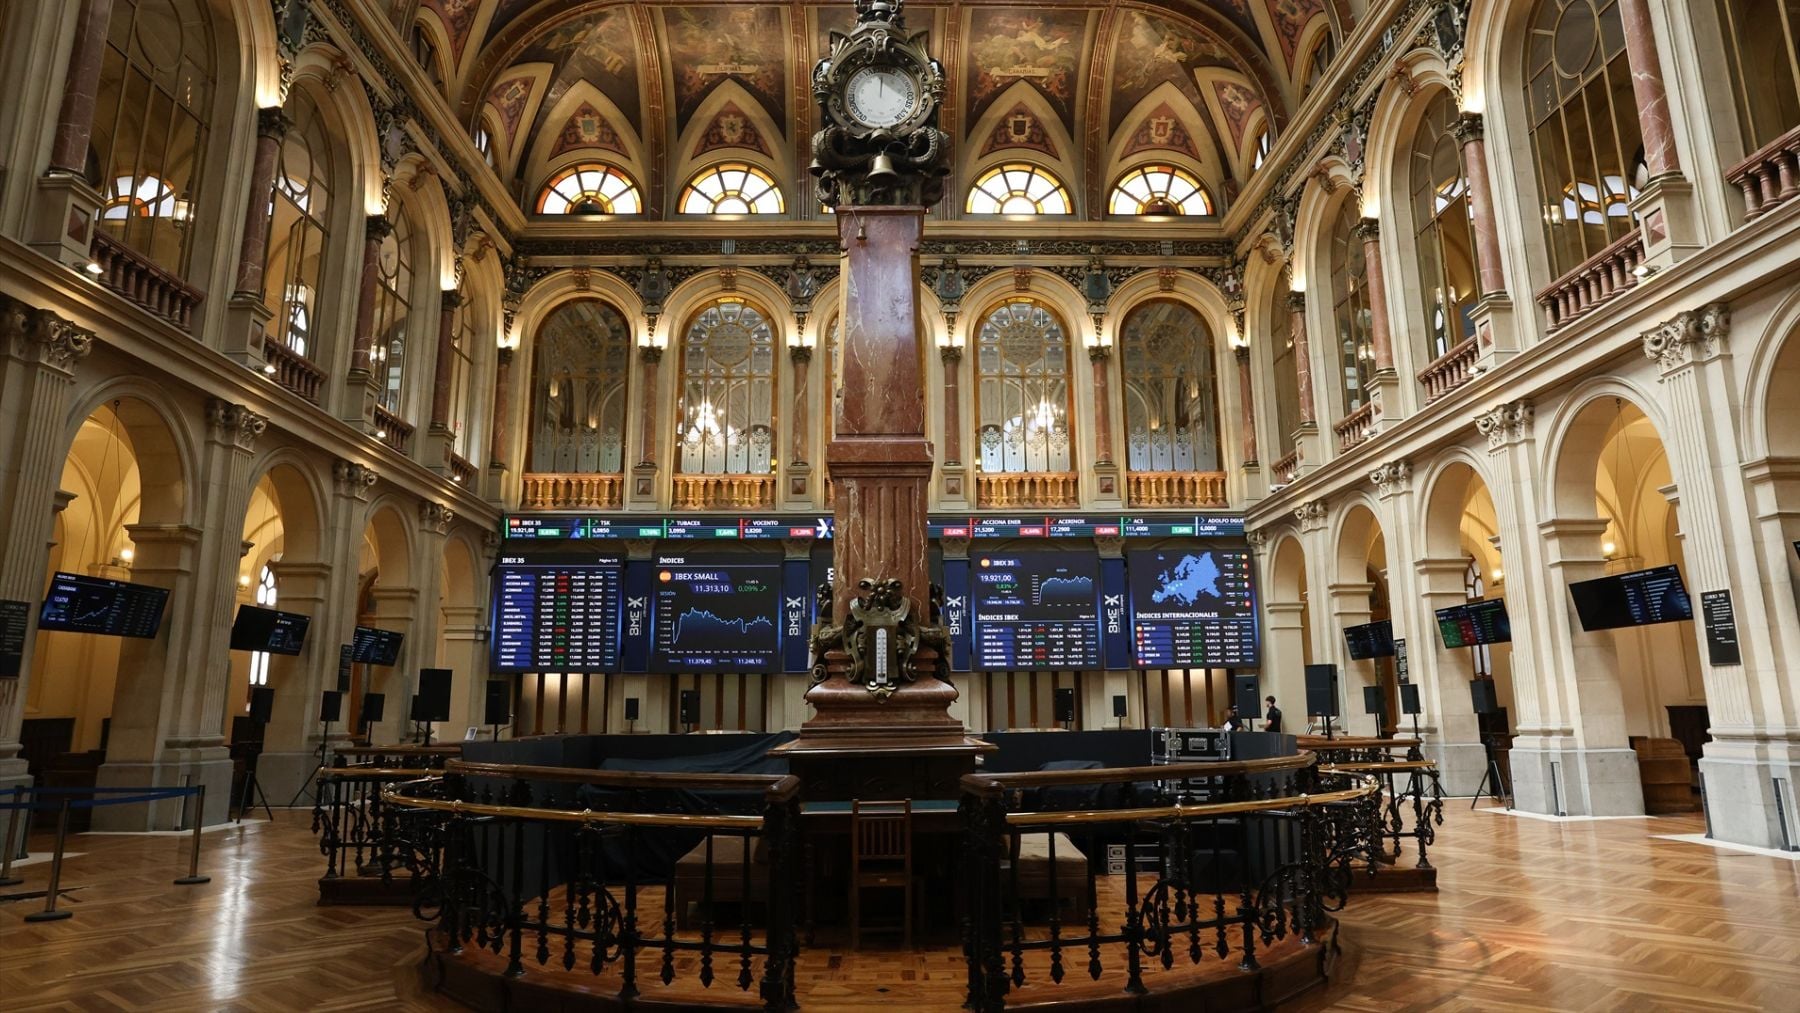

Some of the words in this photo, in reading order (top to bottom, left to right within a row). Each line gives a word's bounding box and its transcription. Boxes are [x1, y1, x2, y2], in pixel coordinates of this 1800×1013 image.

[894, 109, 908, 122] MUY
[905, 91, 914, 109] SECO
[629, 610, 640, 636] BME
[789, 611, 799, 636] BME
[949, 610, 959, 635] BME
[1107, 608, 1118, 634] BME
